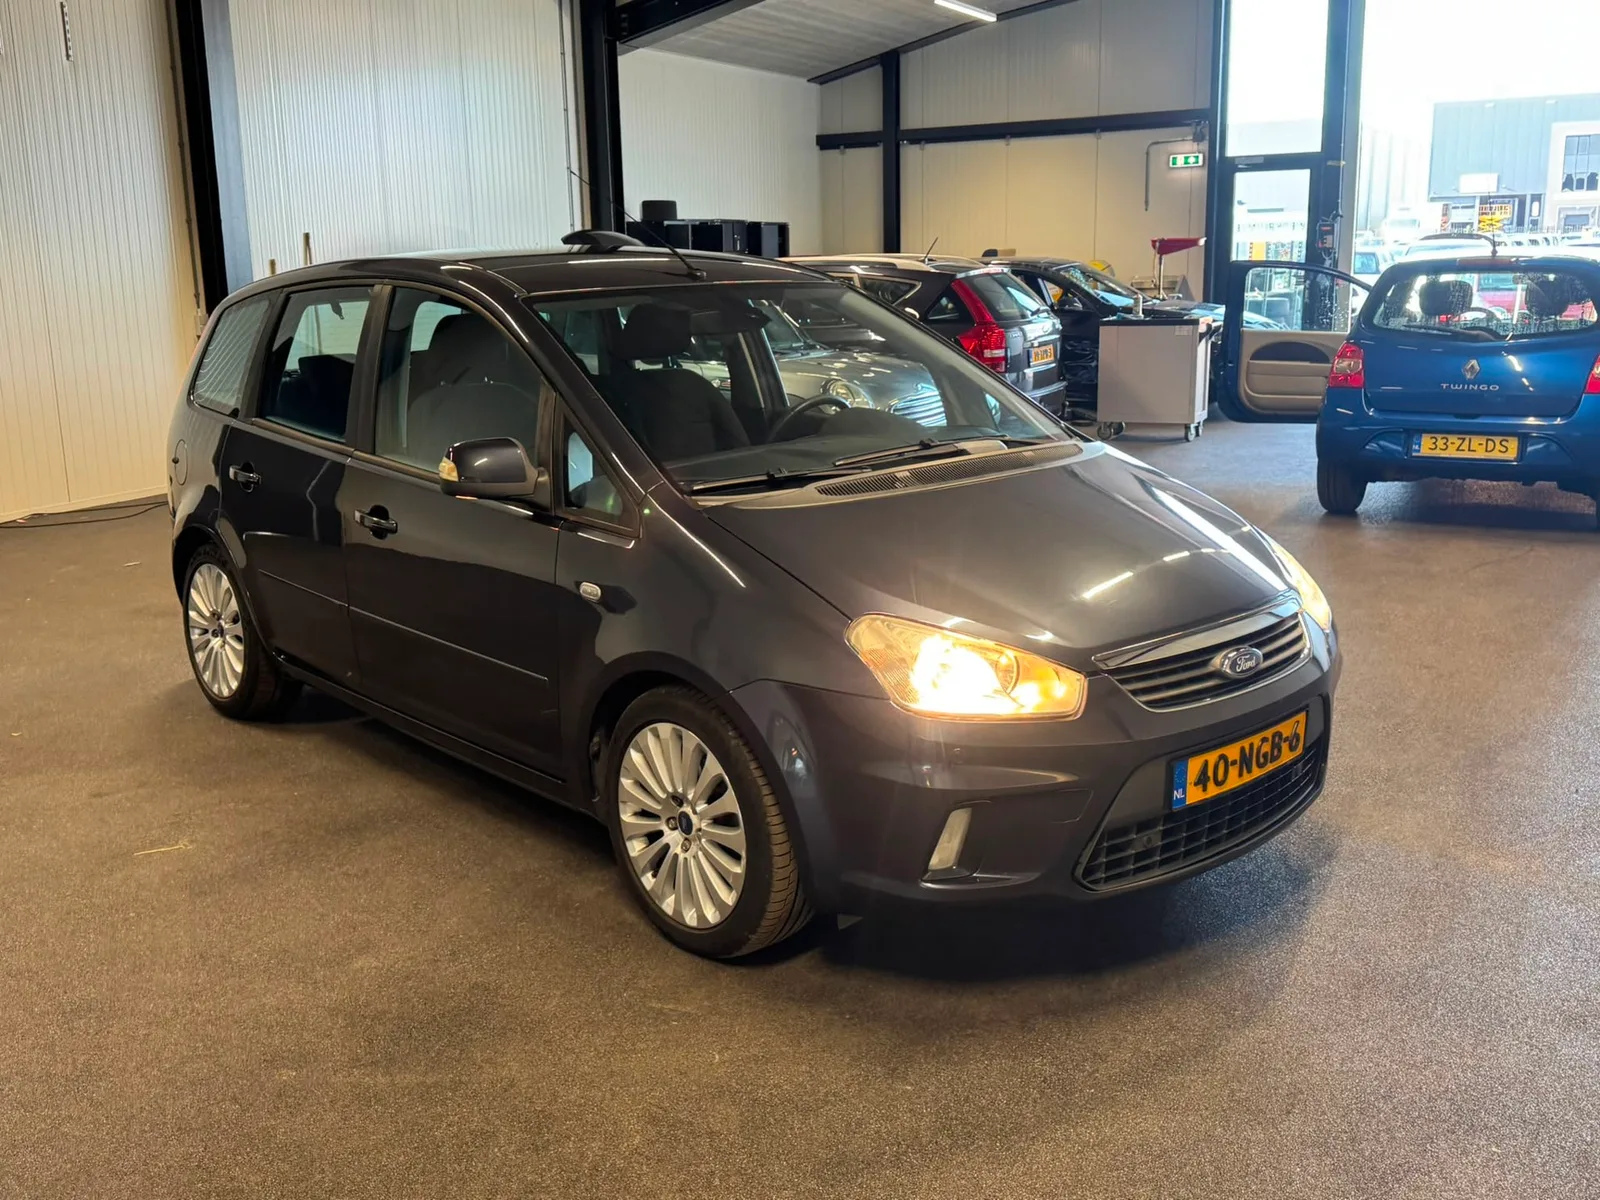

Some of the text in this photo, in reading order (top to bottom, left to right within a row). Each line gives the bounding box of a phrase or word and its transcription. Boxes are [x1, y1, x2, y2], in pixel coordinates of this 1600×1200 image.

[1440, 383, 1500, 391] TWINGO
[1428, 436, 1509, 454] 33-ZL-DS
[1235, 654, 1256, 672] Ford
[1193, 720, 1300, 792] 40-NGB-6
[1173, 788, 1185, 800] NL
